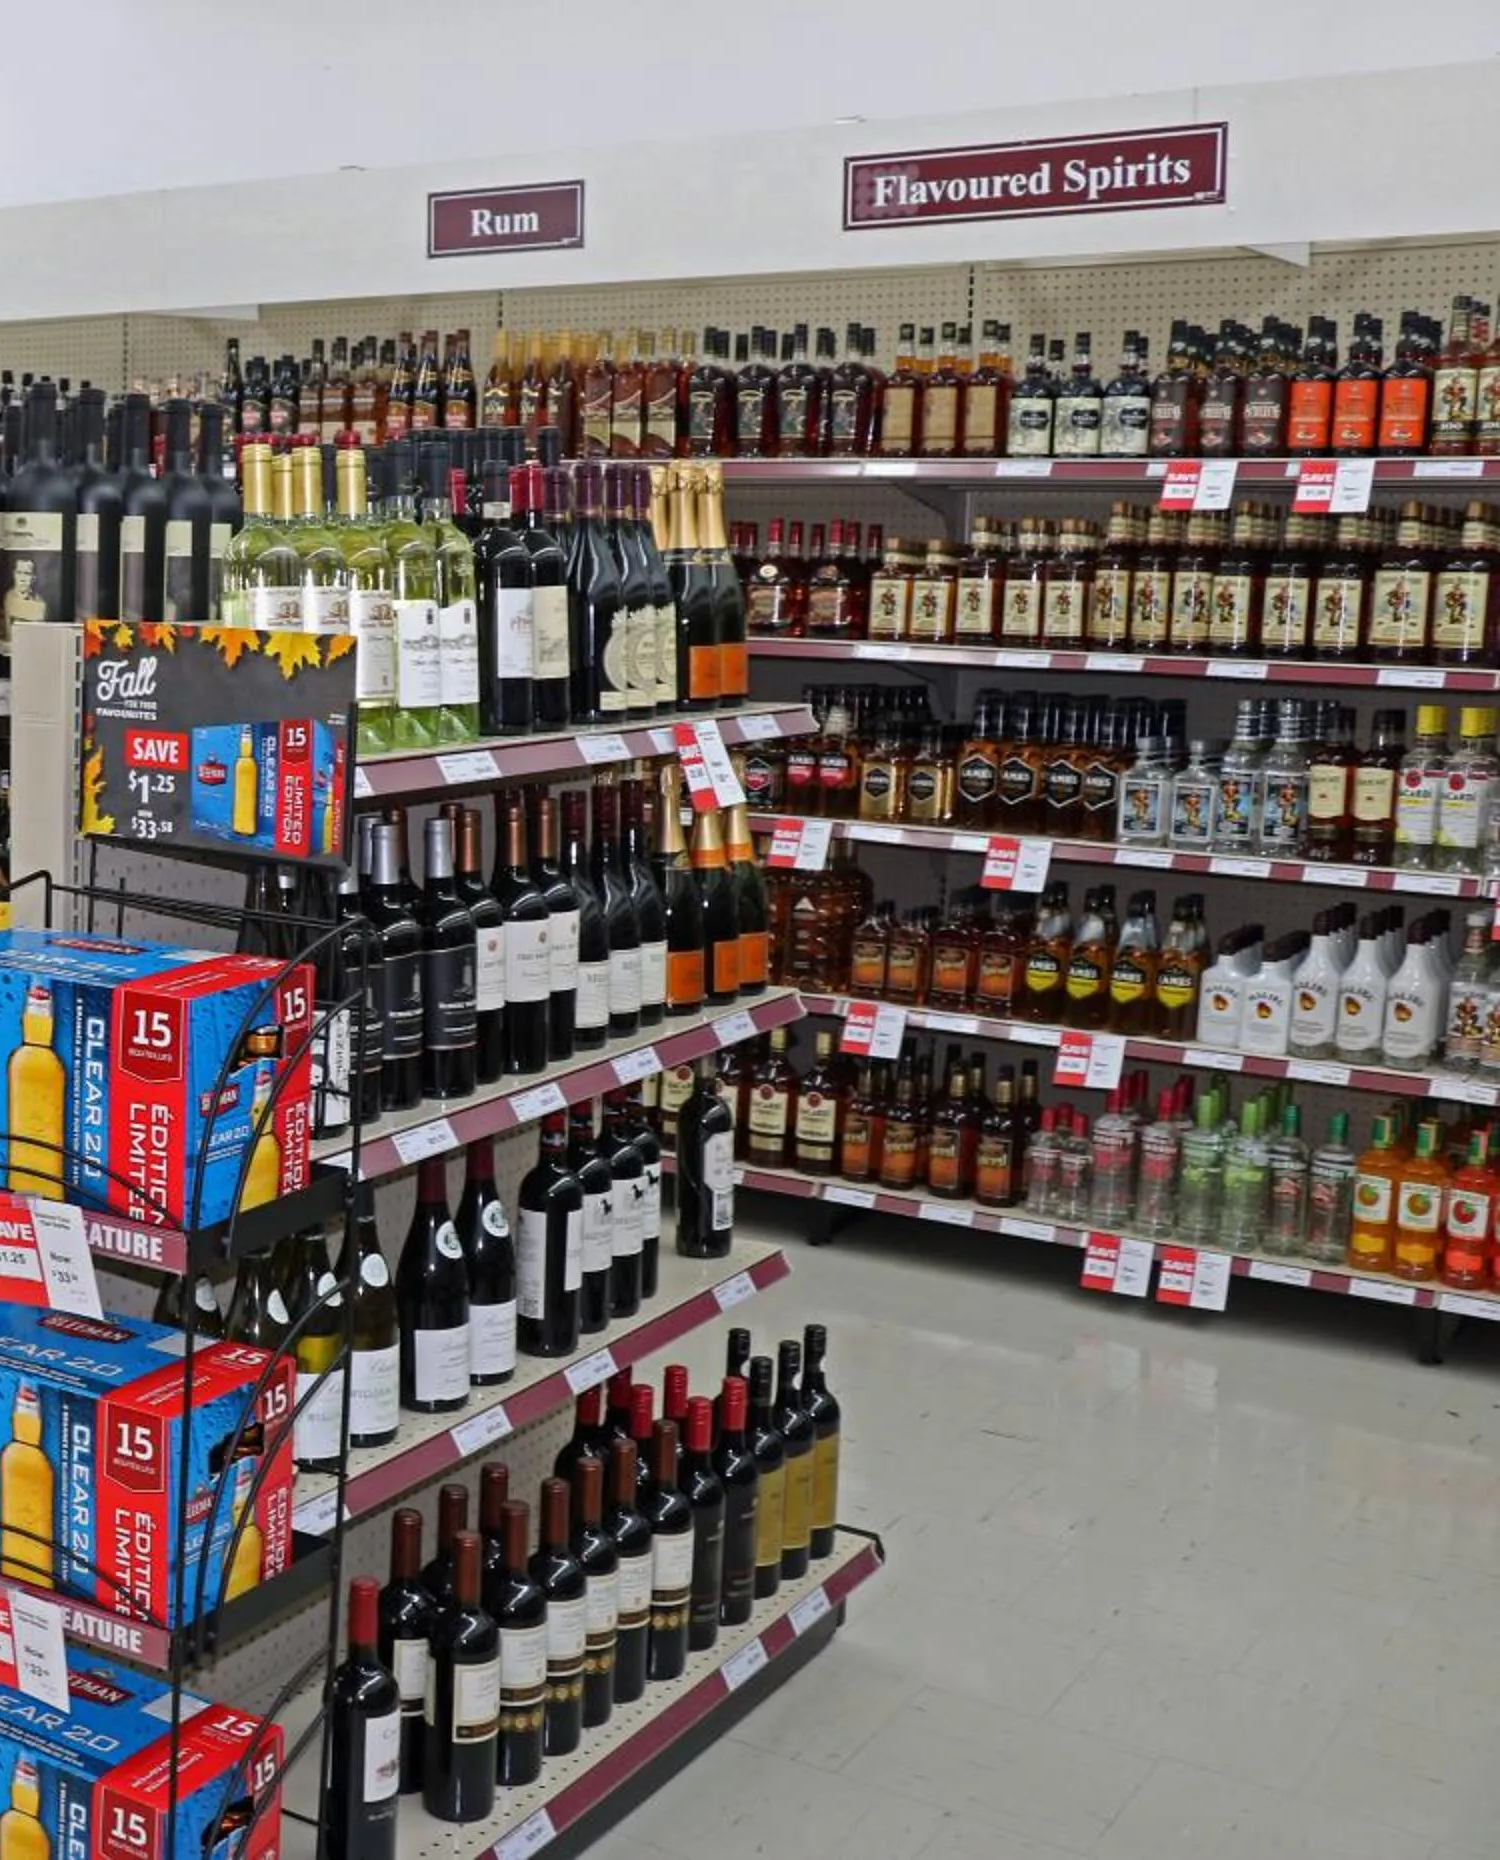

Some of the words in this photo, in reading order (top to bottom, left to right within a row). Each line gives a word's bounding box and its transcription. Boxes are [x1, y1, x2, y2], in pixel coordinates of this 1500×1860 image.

[873, 163, 1051, 208] Flavoured
[1063, 152, 1192, 199] Spirits
[470, 209, 540, 237] Rum
[96, 656, 158, 700] Fall
[96, 707, 158, 721] FAVOURITES
[132, 737, 180, 763] SAVE
[286, 727, 307, 747] 15
[128, 769, 176, 803] $1.25
[283, 988, 306, 1023] 15
[132, 1009, 172, 1048] 15
[85, 1018, 105, 1127] CLEAR
[84, 1219, 164, 1263] ATURE
[64, 1356, 124, 1378] 2.0
[219, 1347, 268, 1366] 15
[264, 1384, 288, 1420] 15
[116, 1423, 154, 1462] 15
[72, 1424, 91, 1526] CLEAR
[61, 1606, 142, 1654] EATURE
[63, 1725, 121, 1752] 2.0
[213, 1714, 260, 1737] 15
[254, 1752, 276, 1792] 15
[111, 1806, 149, 1846] 15
